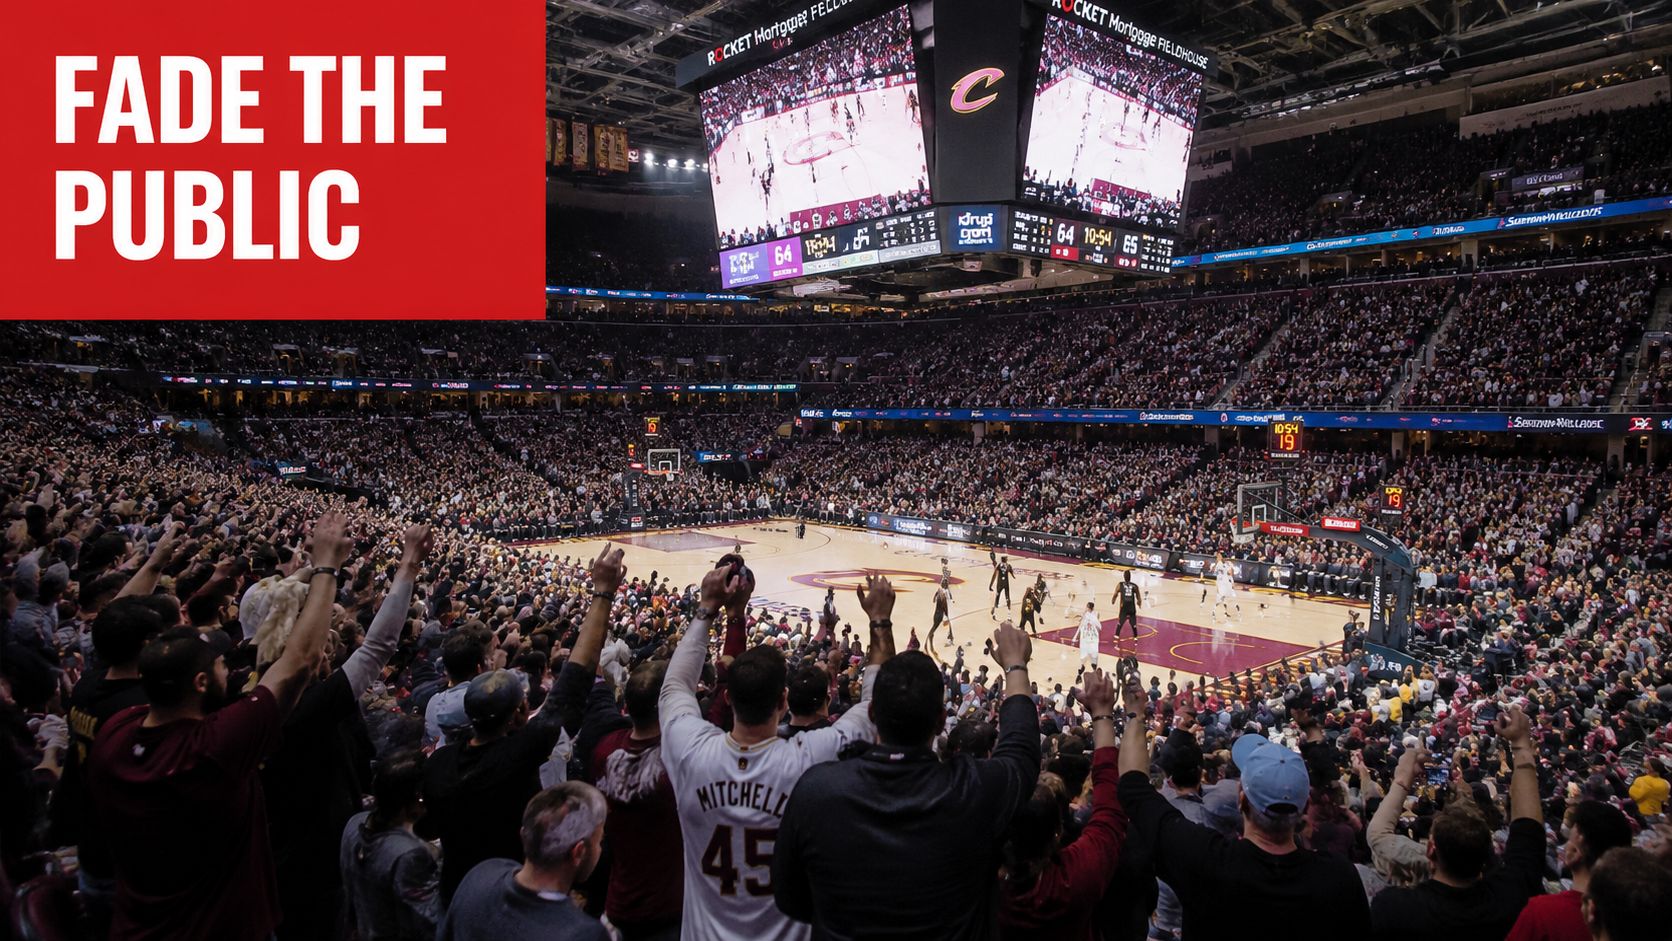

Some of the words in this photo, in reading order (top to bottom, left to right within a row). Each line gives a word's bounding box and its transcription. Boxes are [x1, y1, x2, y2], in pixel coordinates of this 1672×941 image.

[707, 33, 752, 66] ROCKET
[1056, 223, 1075, 246] 64
[774, 244, 793, 265] 64
[1280, 434, 1295, 451] 19
[1388, 494, 1400, 508] 19
[696, 780, 789, 819] MITCHELL
[702, 823, 779, 897] 45
